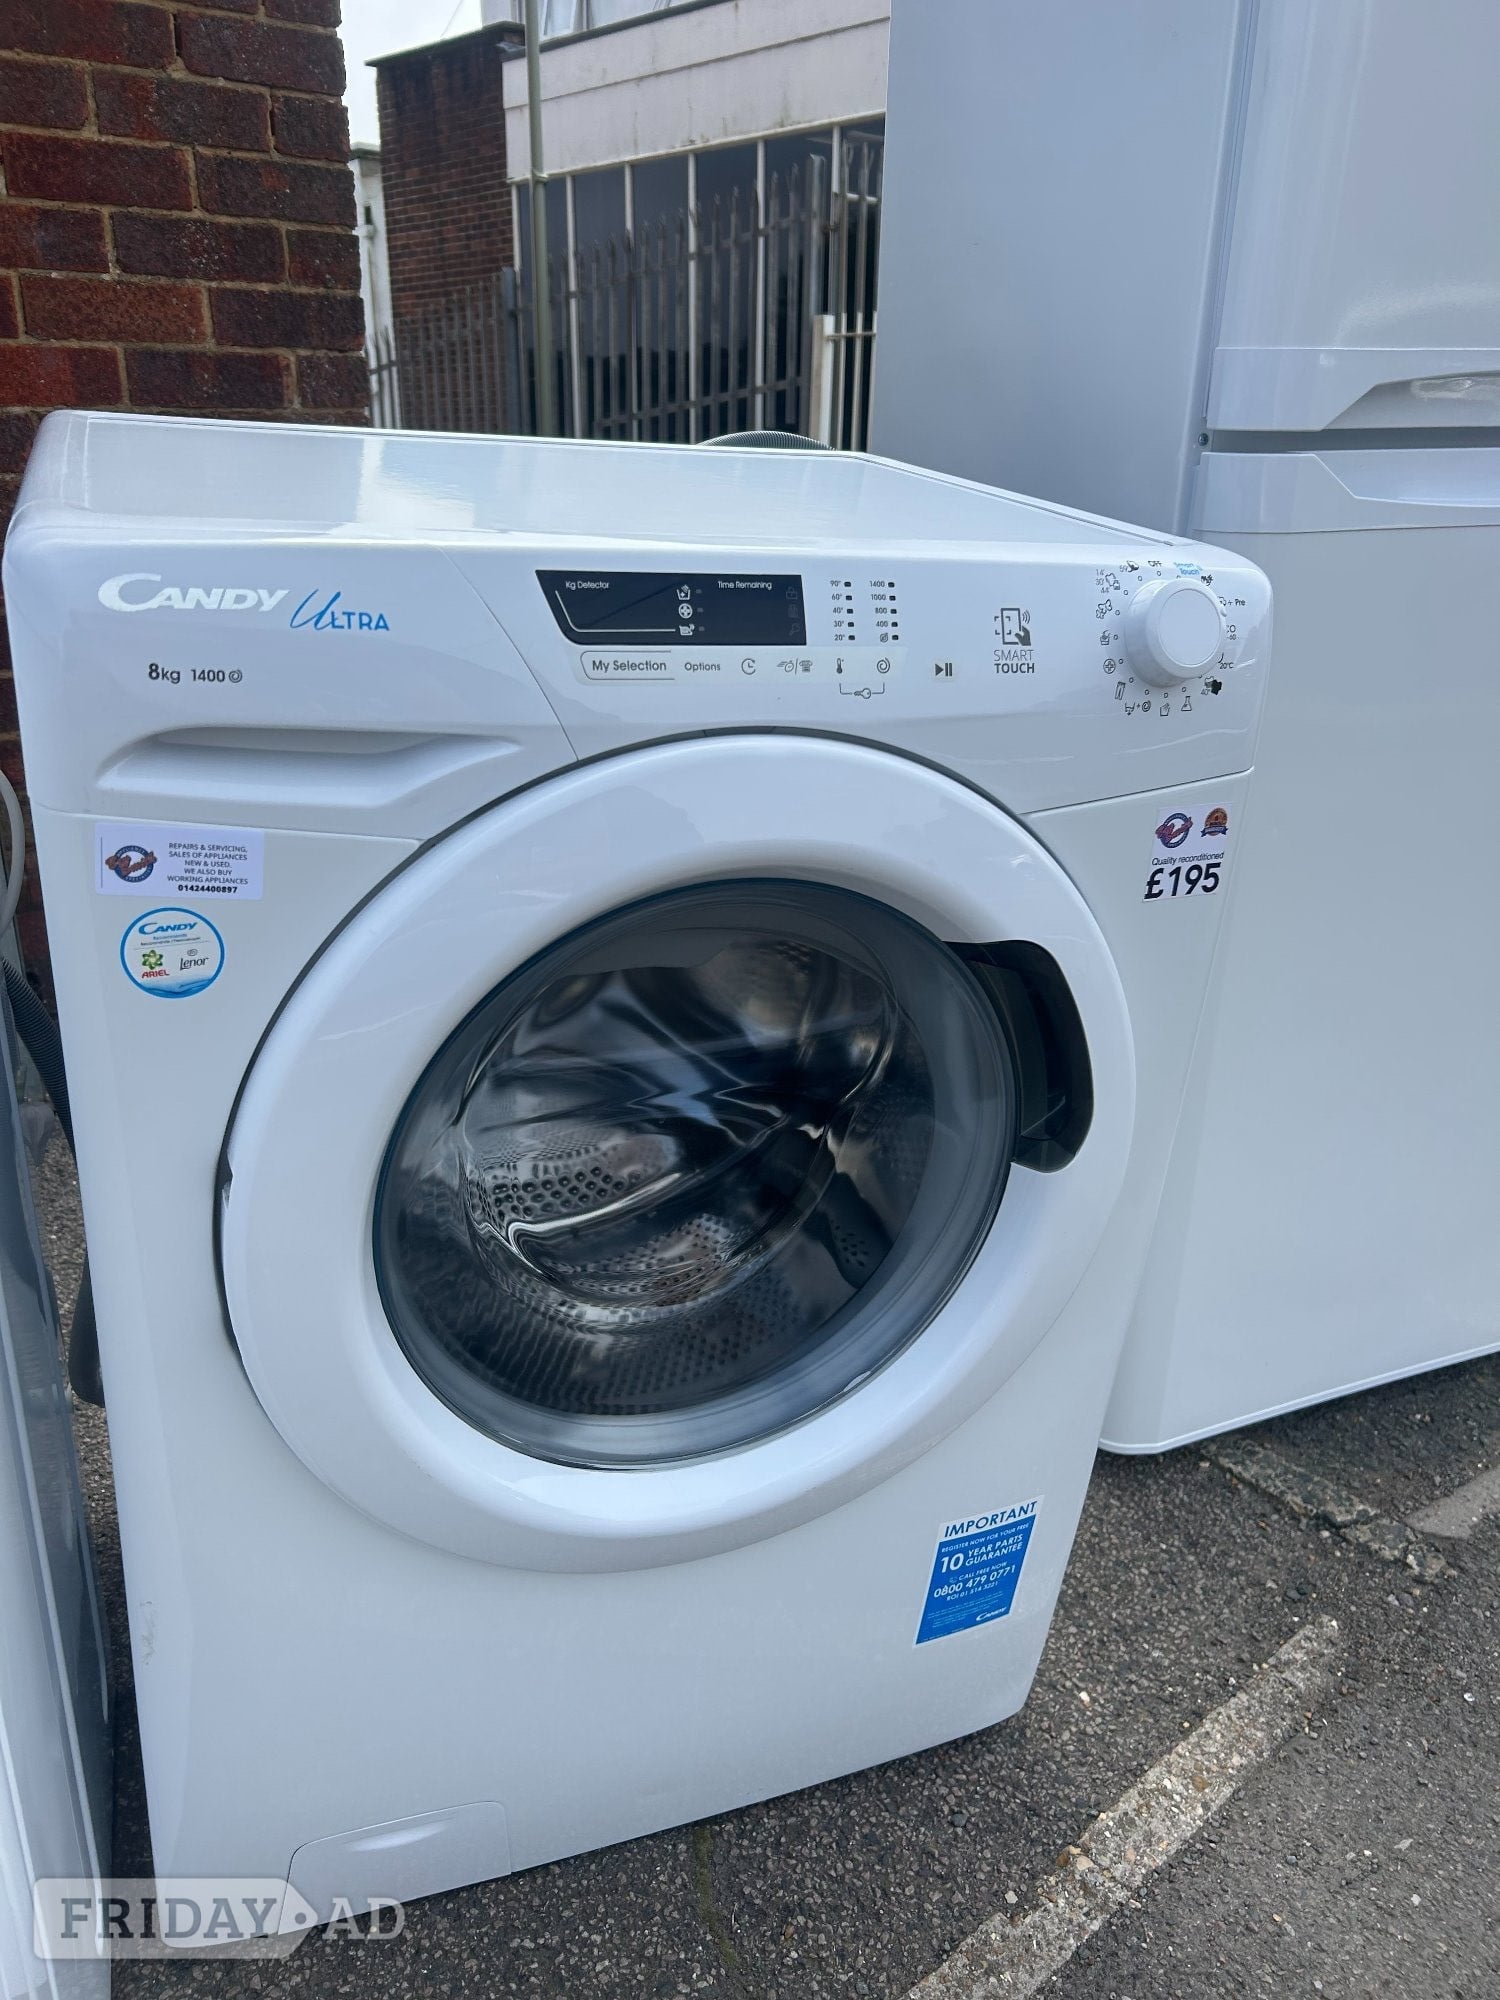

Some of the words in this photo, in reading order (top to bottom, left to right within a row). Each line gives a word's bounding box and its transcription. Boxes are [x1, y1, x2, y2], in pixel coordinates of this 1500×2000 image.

[565, 581, 576, 590] Kg
[577, 581, 609, 589] Detector
[717, 580, 735, 589] Time
[735, 580, 773, 591] Remaining
[97, 572, 290, 612] CANDY
[290, 589, 390, 631] ULTRA
[1234, 598, 1246, 606] Pre
[993, 650, 1034, 661] SMART
[592, 660, 610, 673] My
[613, 660, 667, 671] Selection
[684, 662, 721, 672] Options
[994, 663, 1035, 673] TOUCH
[148, 663, 181, 684] 8kg
[190, 669, 225, 683] 1400
[169, 843, 198, 851] REPAIRS
[203, 852, 247, 861] APPLIANCES
[1151, 856, 1177, 866] Quality
[1178, 851, 1225, 863] reconditioned
[167, 875, 203, 883] WORKING
[205, 876, 248, 885] APPLIANCES
[1144, 862, 1222, 899] £195
[178, 884, 238, 894] 01424400897
[138, 922, 198, 935] CANDY
[180, 957, 209, 971] Lenor
[141, 969, 170, 979] ARIEL
[944, 1501, 1038, 1538] IMPORTANT
[941, 1542, 969, 1553] REGISTER
[969, 1537, 985, 1546] NOW
[986, 1533, 999, 1541] FOR
[1000, 1528, 1016, 1537] YOUR
[1016, 1522, 1030, 1531] FREE
[940, 1553, 965, 1574] 10
[968, 1544, 993, 1557] YEAR
[995, 1534, 1024, 1549] PARTS
[965, 1542, 1023, 1567] GUARANTEE
[958, 1573, 974, 1581] CALL
[976, 1566, 990, 1575] FREE
[990, 1561, 1007, 1571] NOW
[933, 1582, 963, 1598] 0800
[965, 1575, 987, 1588] 479
[989, 1564, 1016, 1581] 0771
